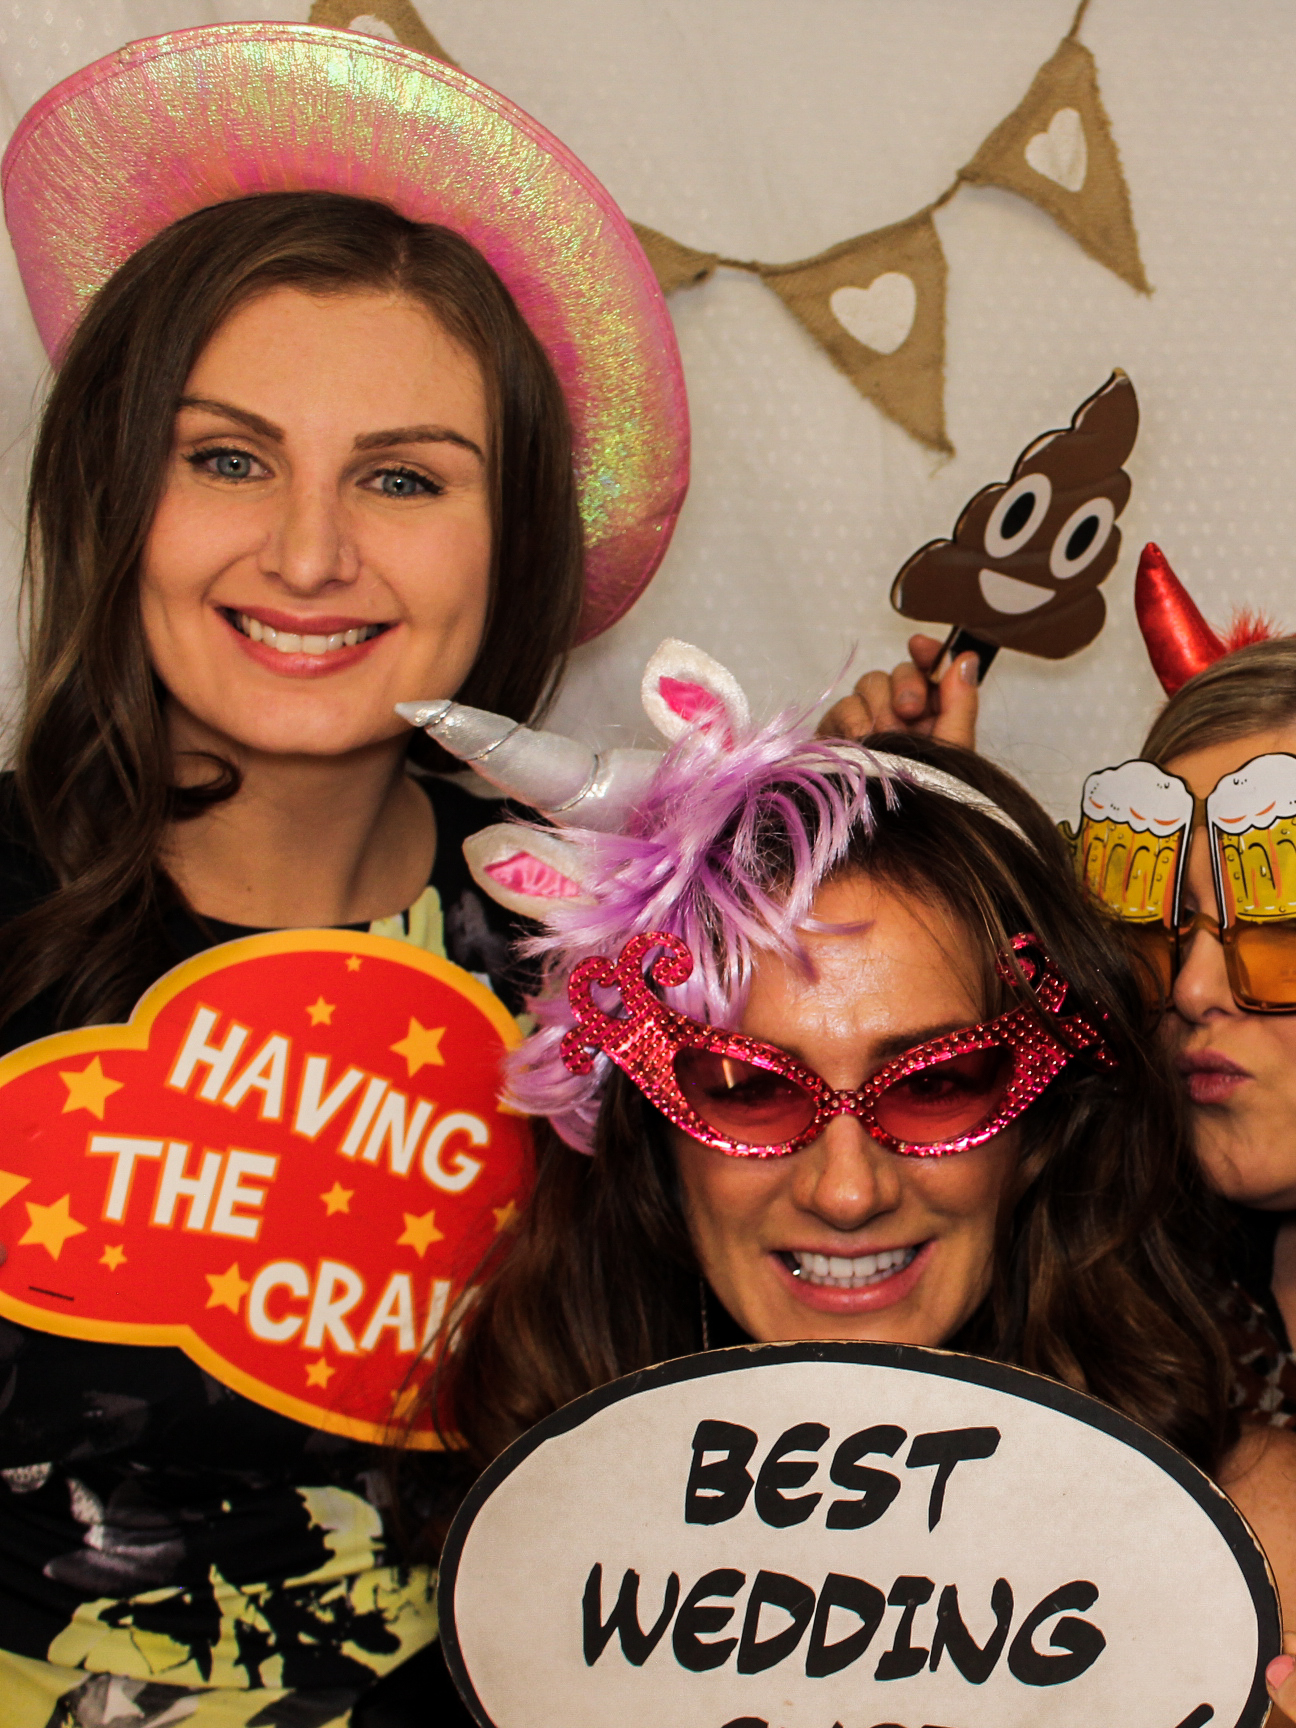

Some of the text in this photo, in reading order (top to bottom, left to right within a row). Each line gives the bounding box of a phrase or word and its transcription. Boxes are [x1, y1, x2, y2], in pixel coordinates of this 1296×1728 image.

[168, 1006, 489, 1192] HAVING
[90, 1135, 278, 1239] THE
[684, 1419, 1002, 1533] BEST
[581, 1562, 1107, 1687] WEDDING
